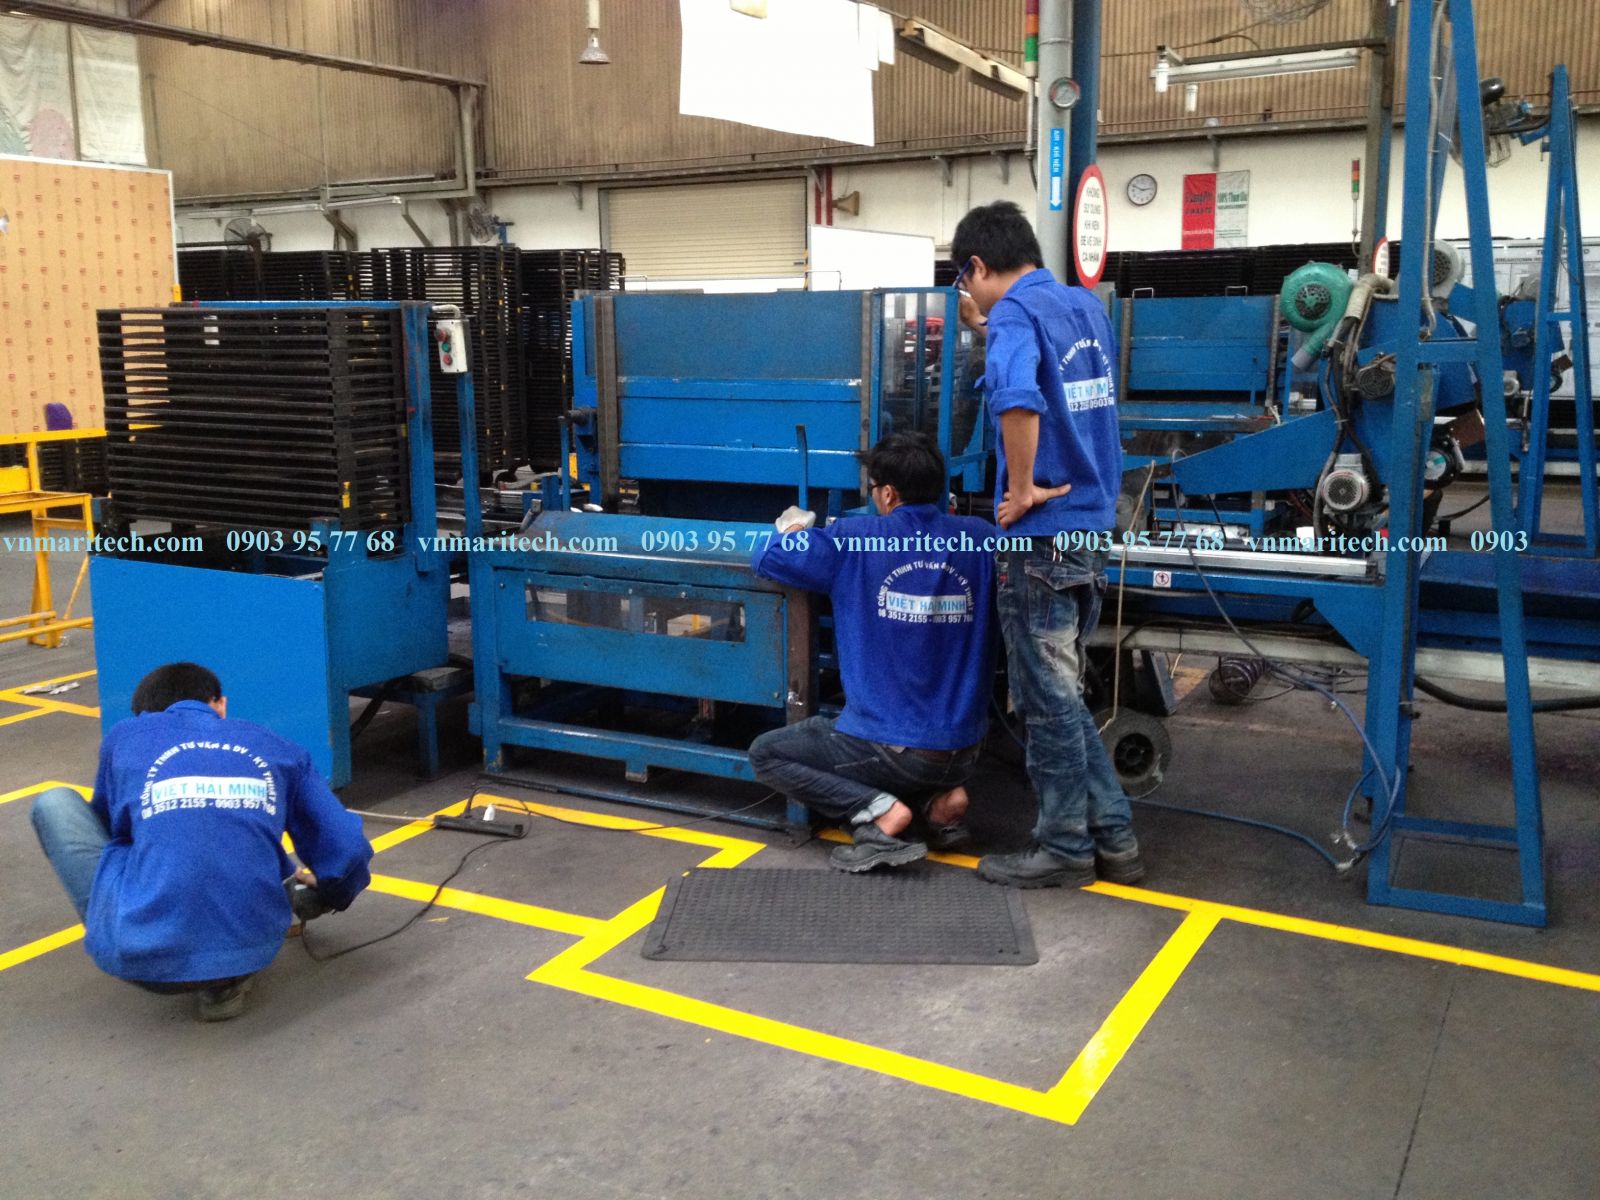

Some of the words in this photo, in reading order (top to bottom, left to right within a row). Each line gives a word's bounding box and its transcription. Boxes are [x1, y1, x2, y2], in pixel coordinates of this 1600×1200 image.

[938, 600, 966, 612] MINH
[888, 610, 907, 622] 3512
[908, 613, 928, 624] 2155
[154, 746, 180, 766] TNHH
[222, 743, 231, 751] &
[229, 783, 268, 798] MINH
[153, 800, 179, 815] 3512
[180, 798, 207, 809] 2155
[242, 799, 260, 809] 957
